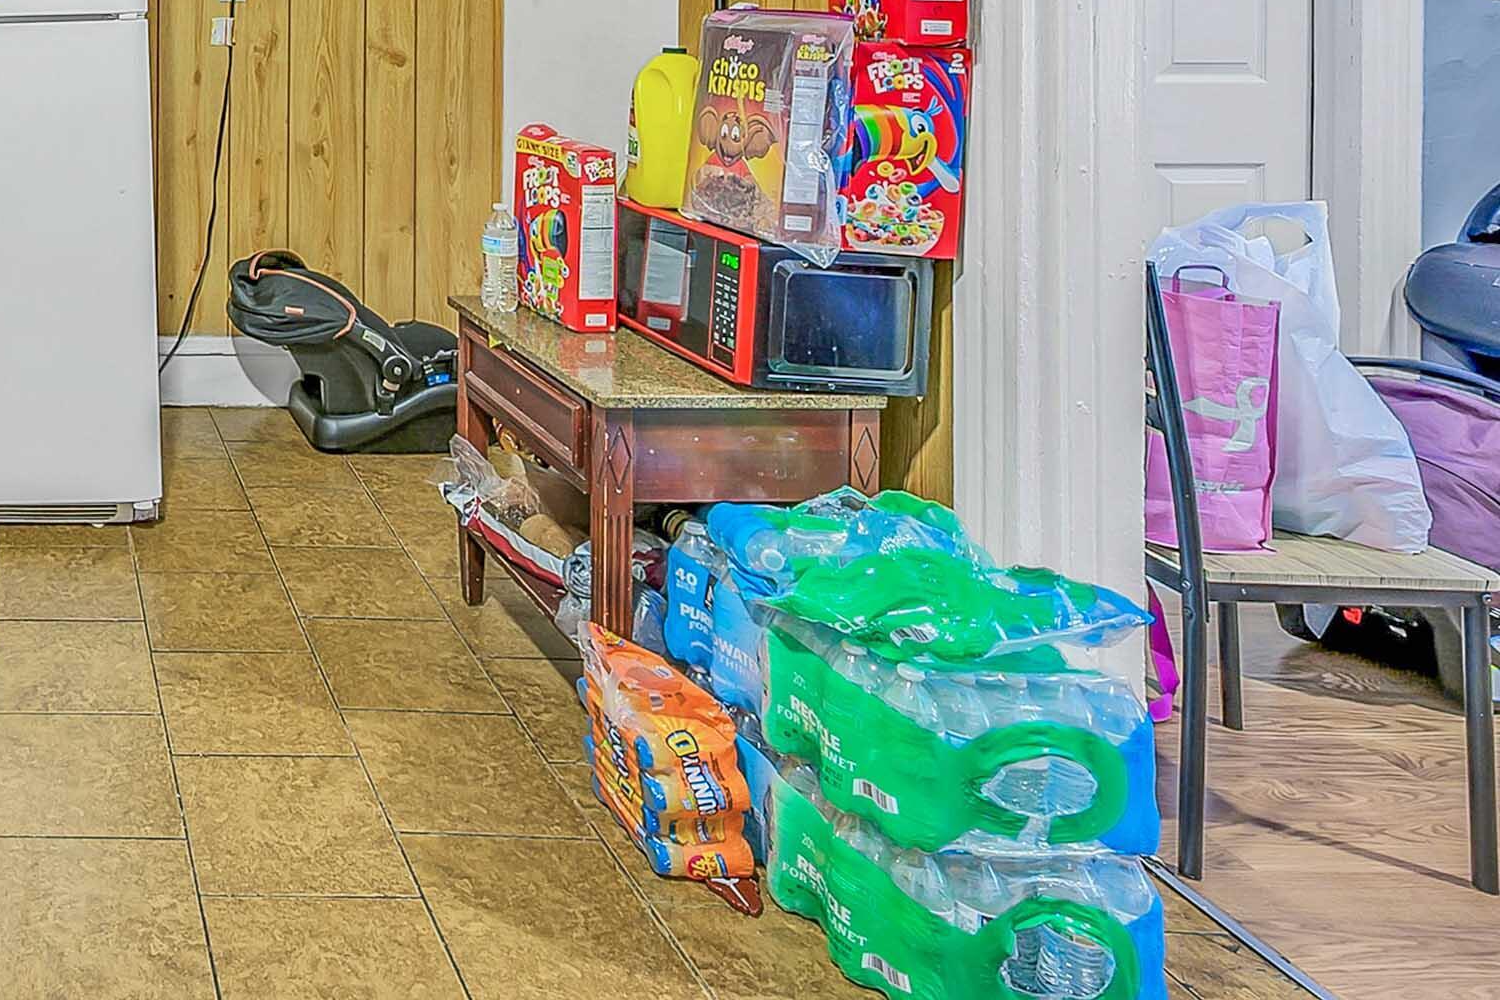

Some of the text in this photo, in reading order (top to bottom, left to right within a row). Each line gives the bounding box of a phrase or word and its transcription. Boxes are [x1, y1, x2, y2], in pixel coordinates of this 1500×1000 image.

[867, 57, 923, 81] FROOT
[951, 53, 965, 68] 2
[708, 70, 766, 102] KRISPIS
[873, 73, 925, 94] LOOPS
[516, 139, 560, 159] GIANT SIZE
[523, 166, 559, 191] FROOT
[526, 185, 560, 208] LOOPS
[675, 567, 698, 586] 40
[776, 704, 801, 724] FOR
[782, 862, 807, 883] FOR
